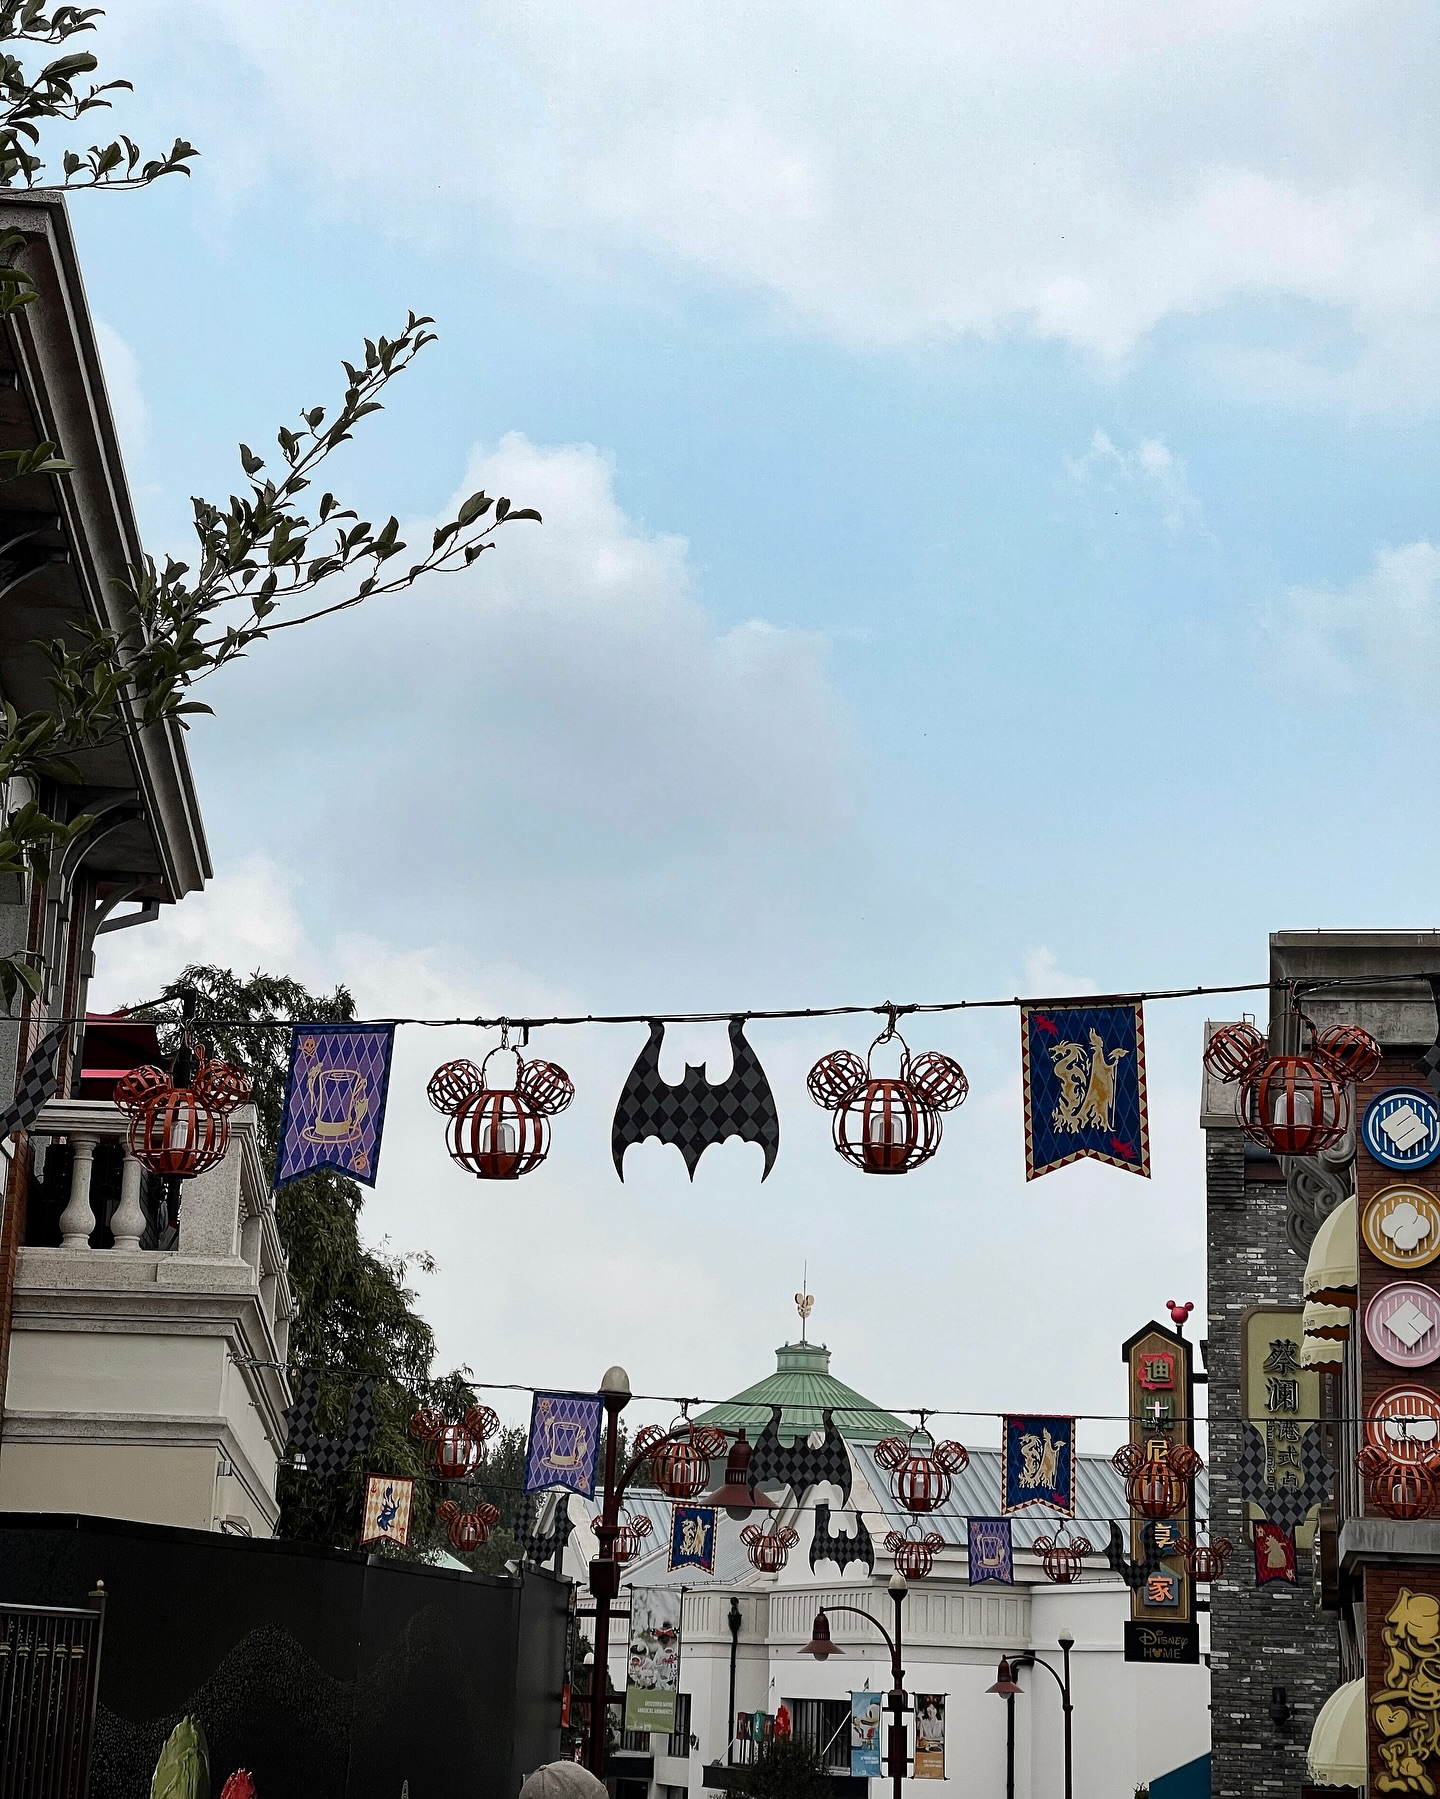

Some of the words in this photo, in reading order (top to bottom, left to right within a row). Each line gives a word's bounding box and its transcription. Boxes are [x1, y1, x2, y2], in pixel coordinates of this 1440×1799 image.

[1145, 1359, 1175, 1602] 迪士尼享家
